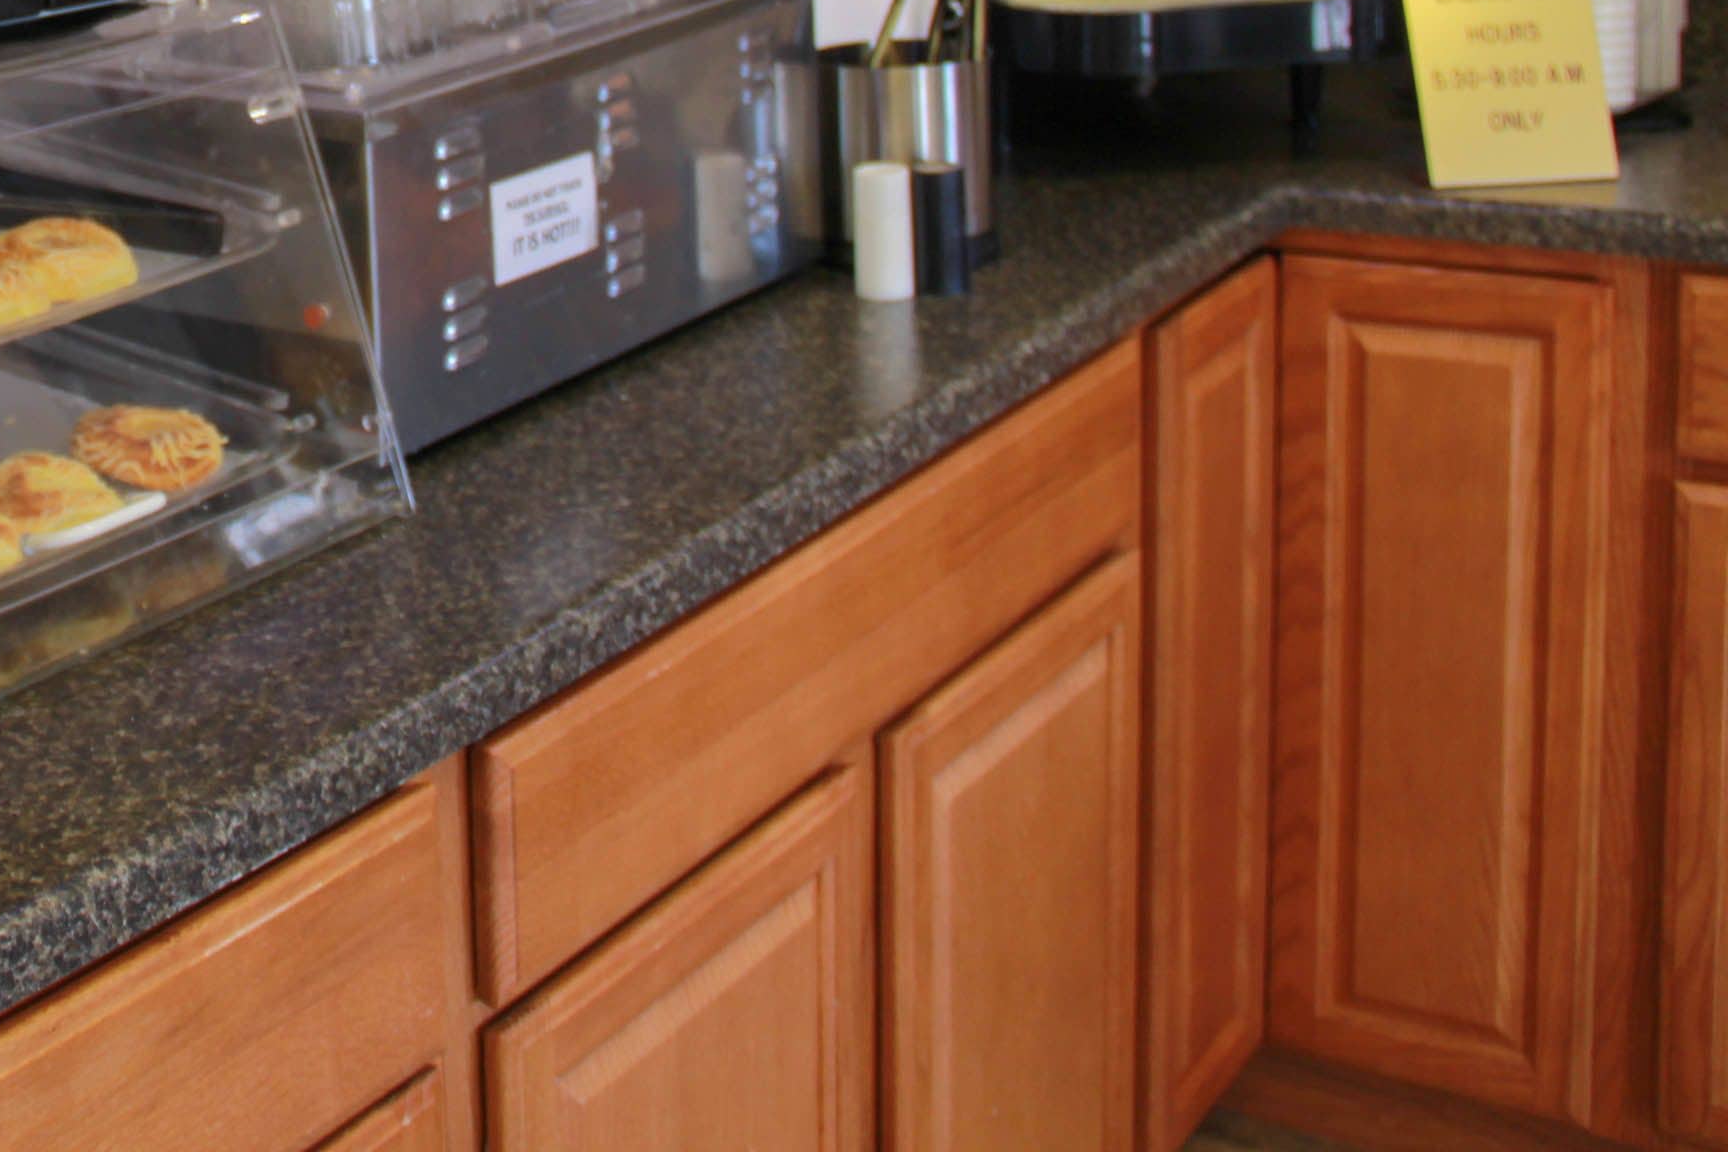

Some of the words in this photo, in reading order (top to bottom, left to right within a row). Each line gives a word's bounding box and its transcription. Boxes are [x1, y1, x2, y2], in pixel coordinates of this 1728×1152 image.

[1464, 20, 1541, 44] HOURS
[1487, 110, 1544, 133] ONLY
[512, 235, 525, 257] IT
